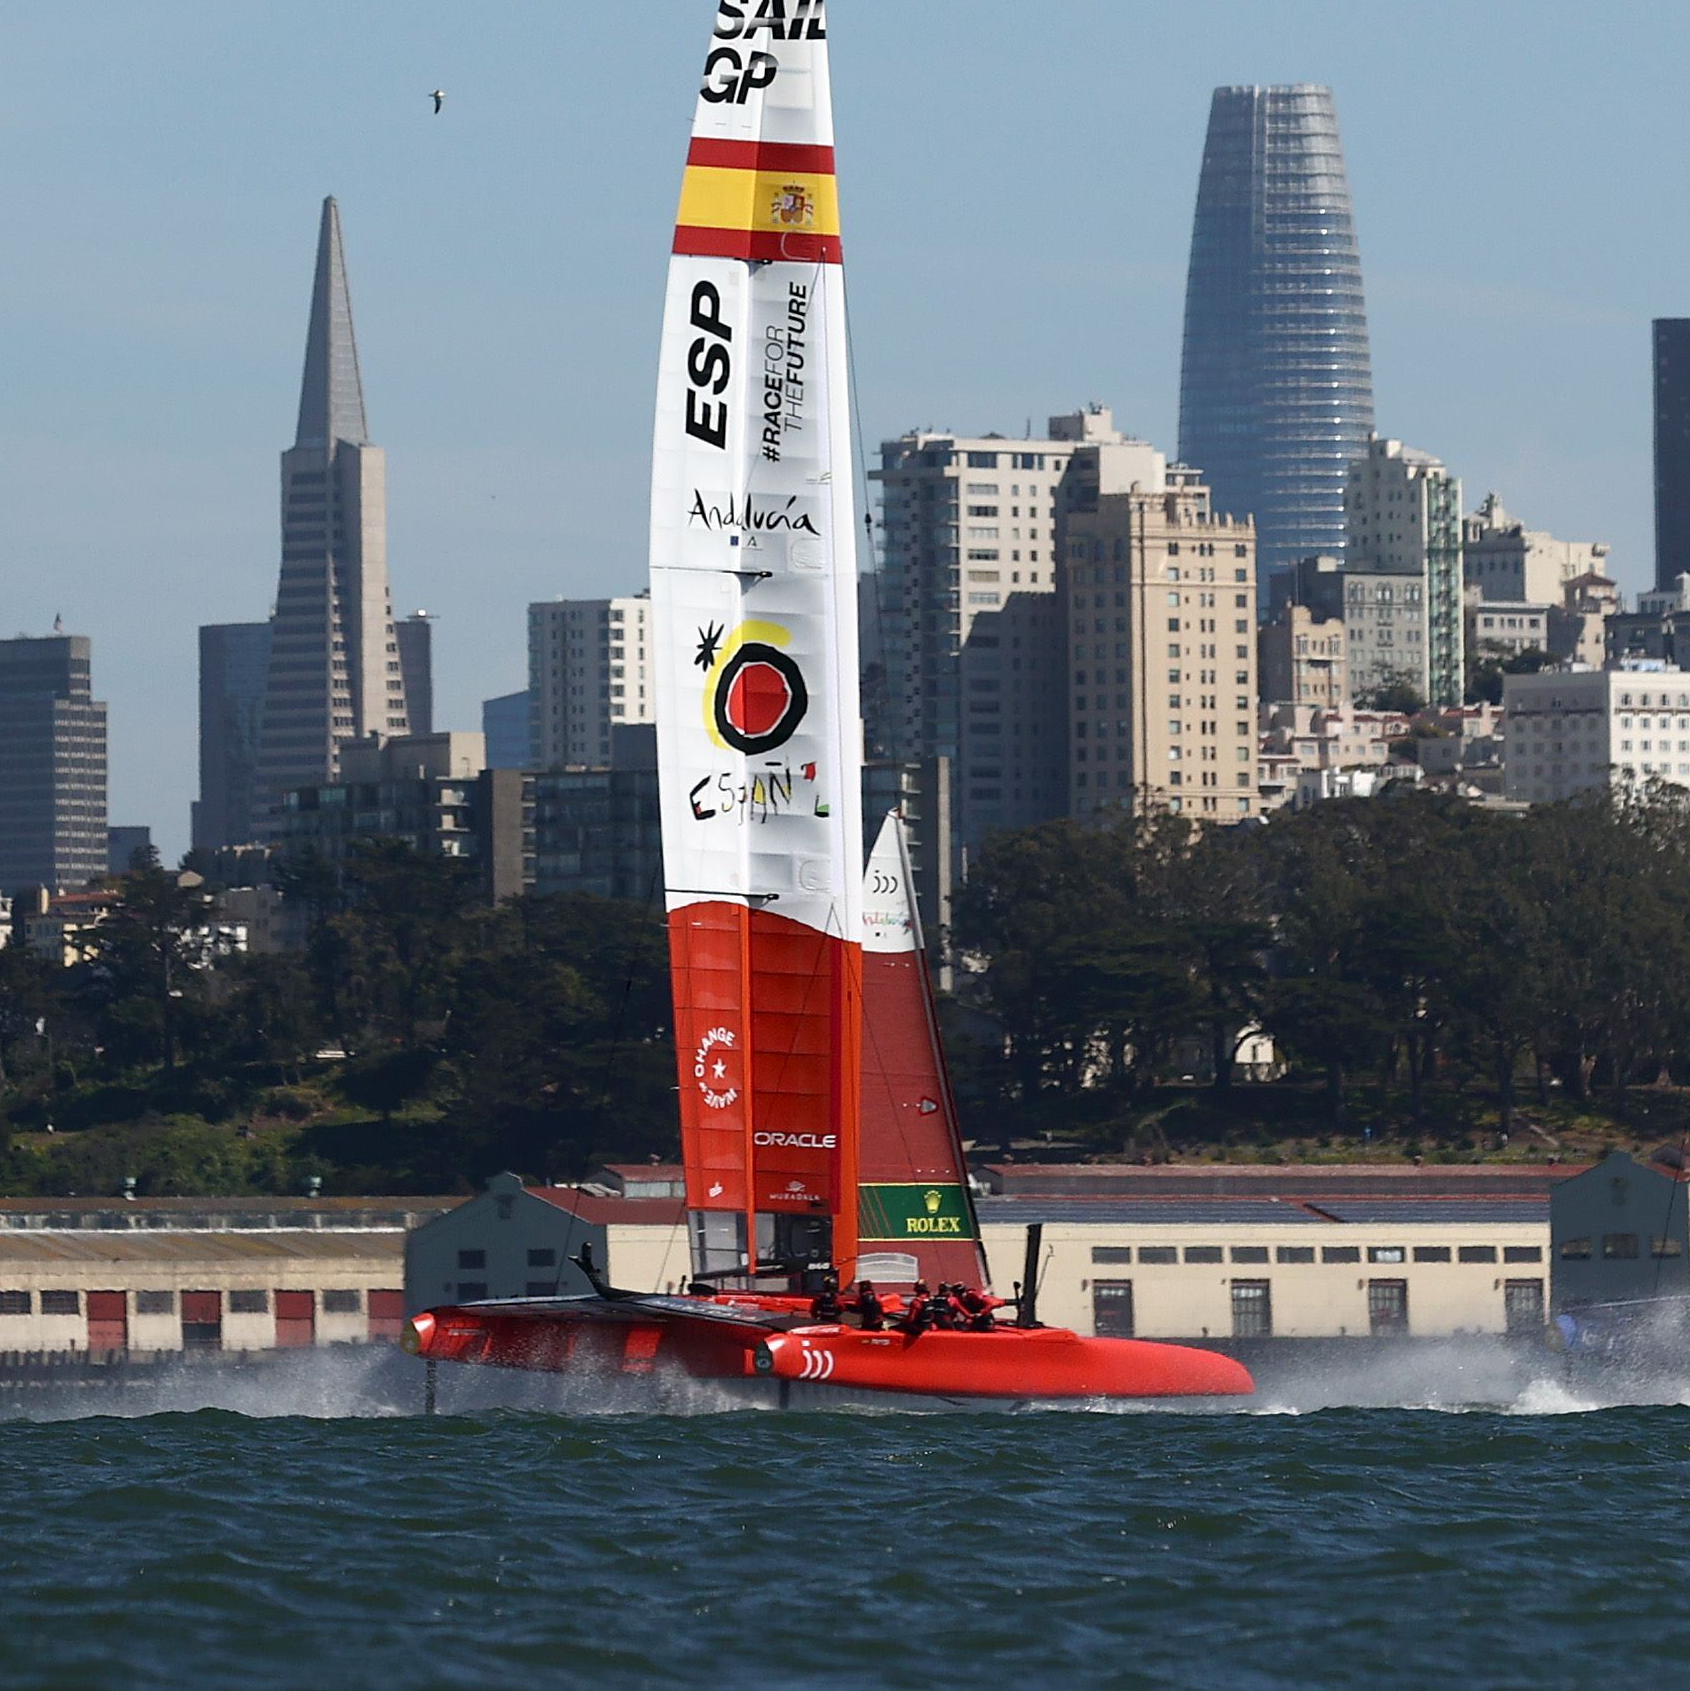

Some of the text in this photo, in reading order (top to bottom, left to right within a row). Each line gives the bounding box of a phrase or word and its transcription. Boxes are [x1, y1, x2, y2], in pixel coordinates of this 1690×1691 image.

[699, 47, 779, 105] GP
[685, 279, 732, 450] ESP
[754, 1132, 837, 1149] ORACLE
[906, 1217, 961, 1233] ROLEX
